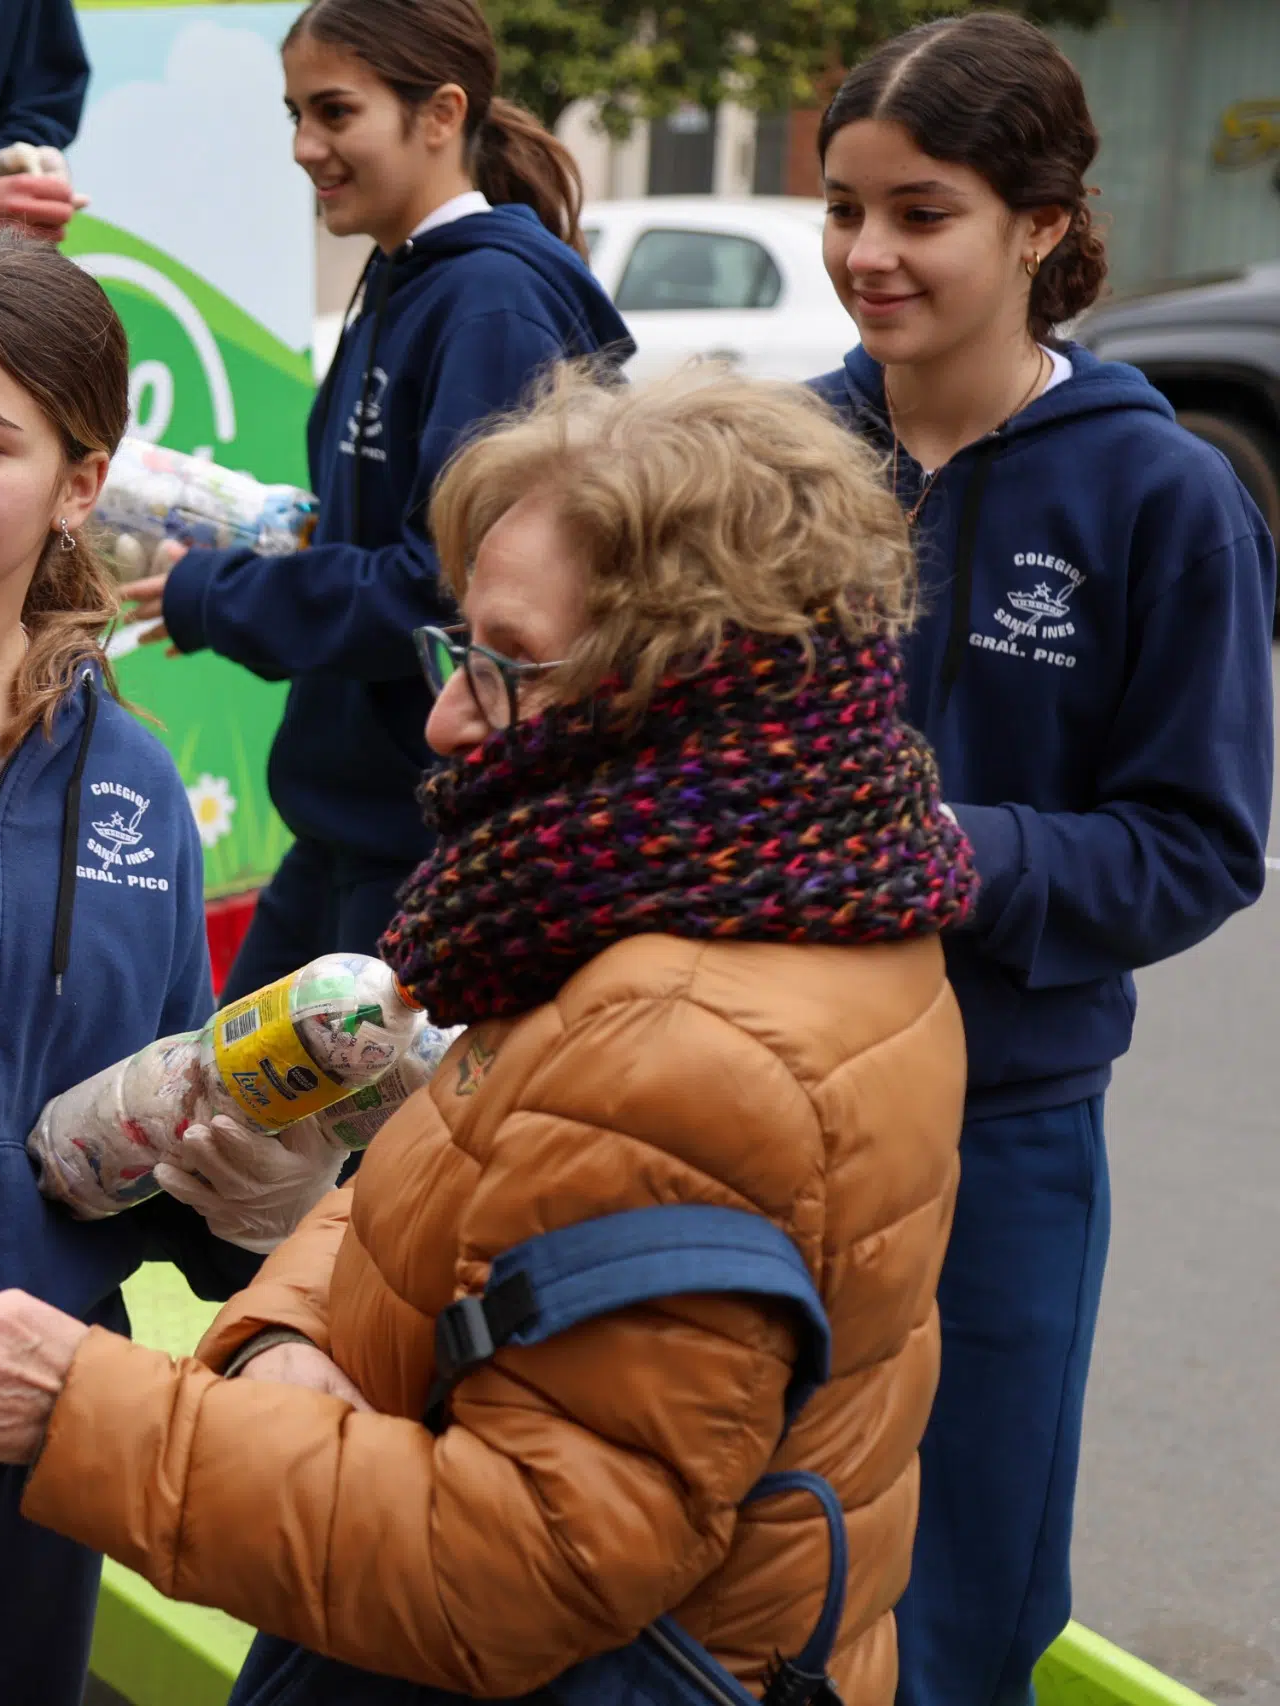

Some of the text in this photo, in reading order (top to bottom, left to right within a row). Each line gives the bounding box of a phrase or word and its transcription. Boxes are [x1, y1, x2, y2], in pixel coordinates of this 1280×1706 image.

[1013, 552, 1081, 581] COLEGIO
[993, 608, 1076, 639] SANTA INES
[969, 633, 1077, 668] GRAL. PICO
[90, 781, 145, 809] COLEGIO
[86, 838, 155, 866] SANTA INES
[75, 865, 169, 891] GRAL. PICO
